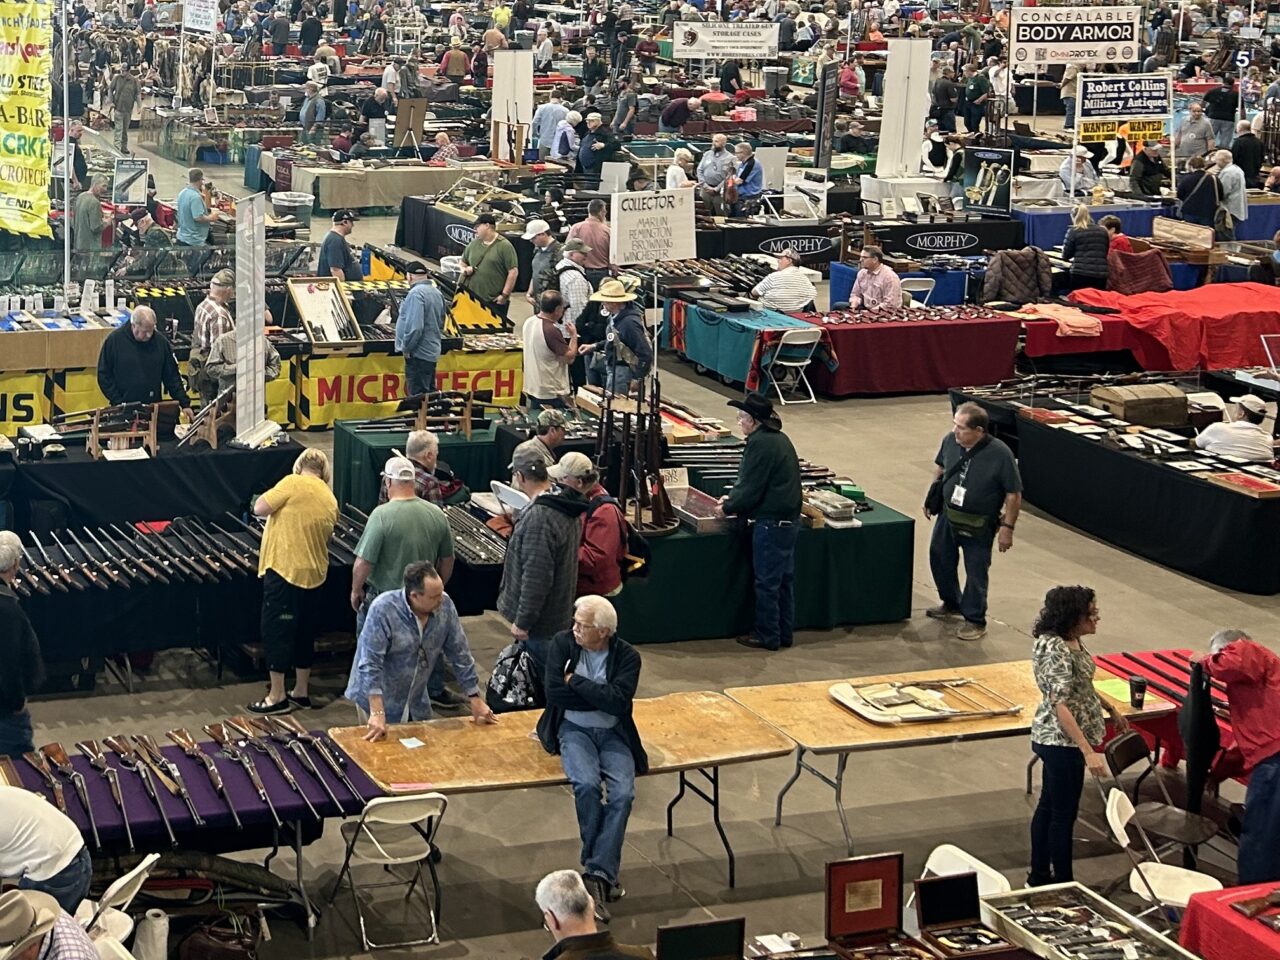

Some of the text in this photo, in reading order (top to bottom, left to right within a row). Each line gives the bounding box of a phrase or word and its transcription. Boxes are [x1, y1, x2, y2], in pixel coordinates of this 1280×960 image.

[1021, 11, 1133, 22] CONCEALABLE
[1019, 25, 1132, 40] BODY ARMOR
[1235, 51, 1250, 67] 5
[1086, 80, 1166, 93] Robert Collins
[1083, 98, 1168, 109] Military Antiques
[1083, 121, 1117, 133] WANTED
[1129, 120, 1162, 132] WANTED
[621, 195, 675, 211] COLLECTOR
[637, 216, 668, 228] MARLIN
[450, 226, 477, 243] MORP
[628, 227, 672, 239] REMINGTON
[631, 238, 673, 251] BROWNING
[769, 239, 825, 253] MORPHY
[916, 234, 969, 248] MORPHY
[623, 249, 669, 262] WINCHESTER
[317, 369, 516, 406] MICRTECH
